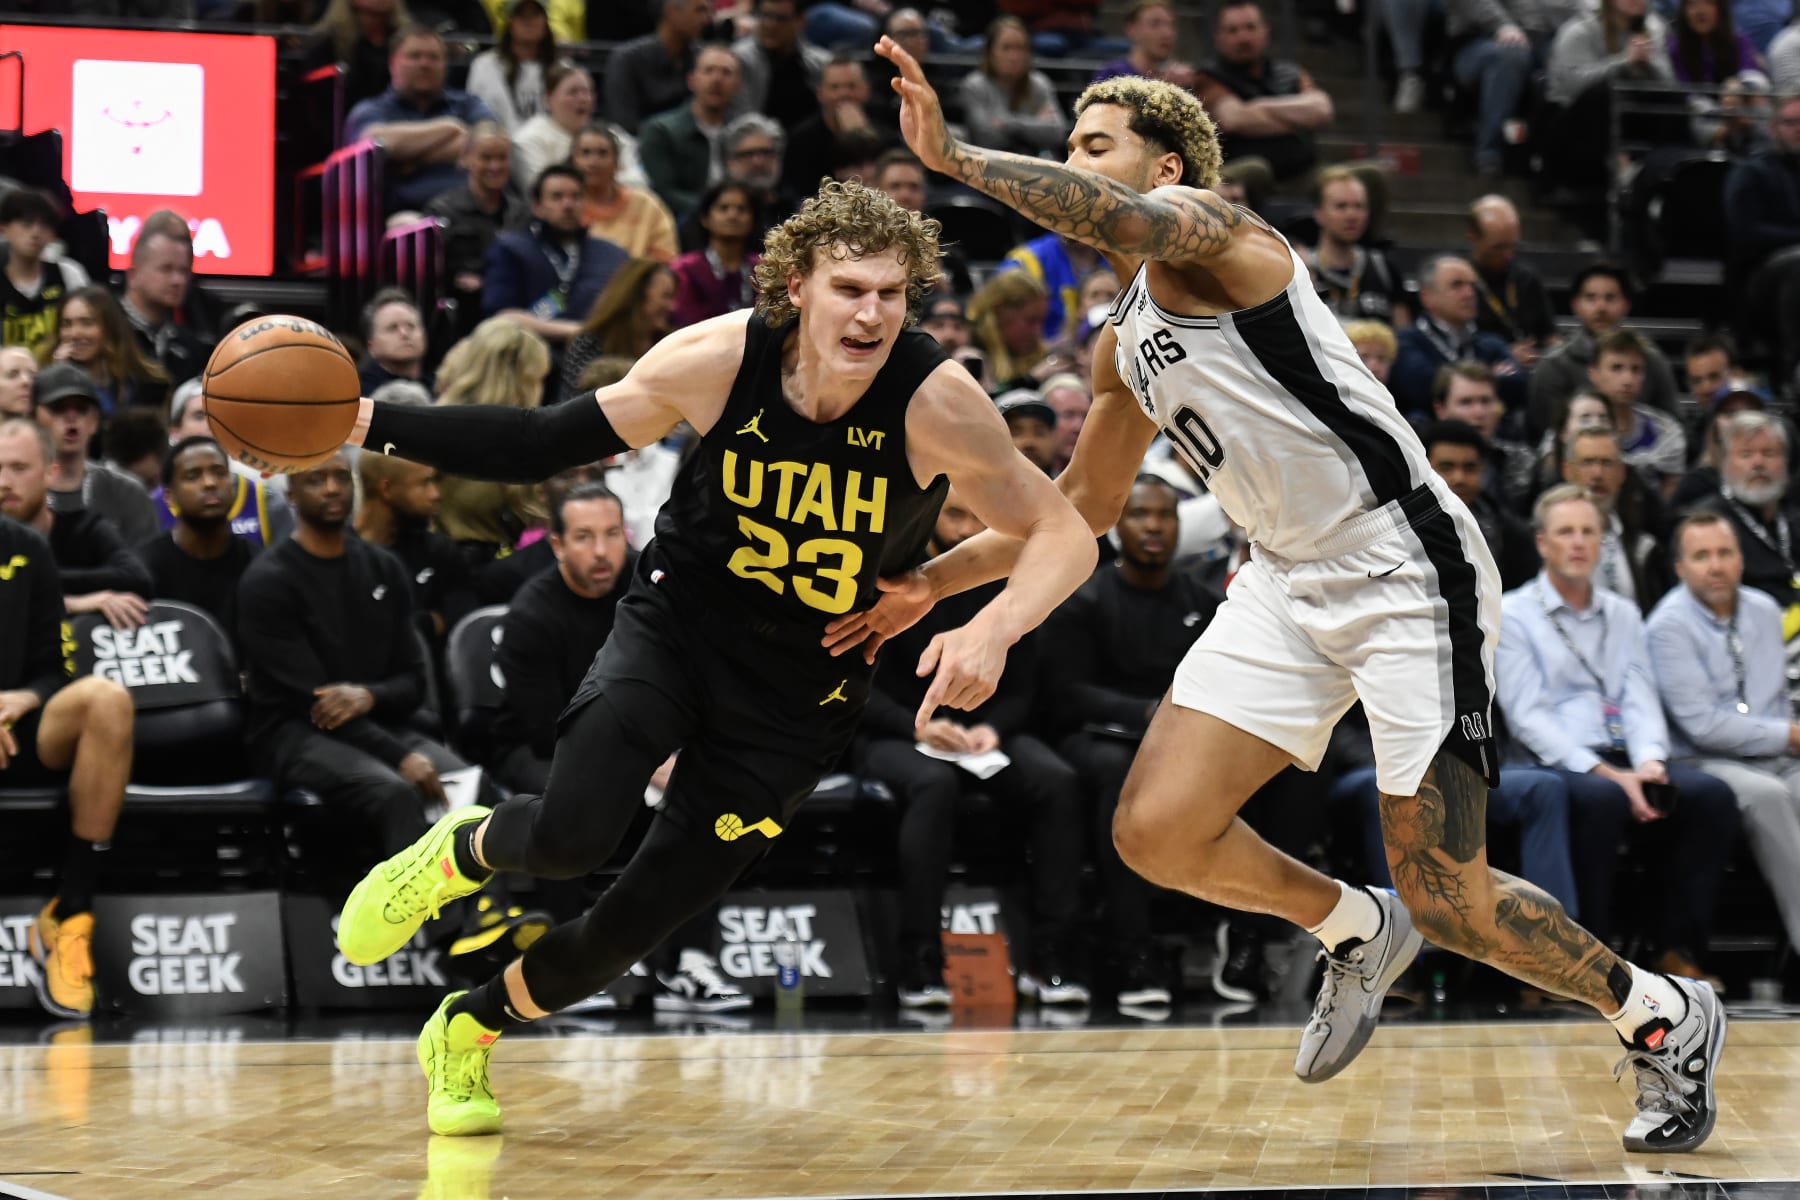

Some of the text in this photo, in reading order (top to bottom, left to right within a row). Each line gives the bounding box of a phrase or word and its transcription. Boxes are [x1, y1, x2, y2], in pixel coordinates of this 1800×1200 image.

[847, 426, 886, 451] LVT
[722, 449, 888, 534] UTAH
[726, 514, 864, 615] 23
[91, 619, 184, 659] SEAT
[93, 650, 200, 688] GEEK
[131, 912, 238, 956] SEAT
[718, 904, 817, 944] SEAT
[128, 952, 245, 995] GEEK
